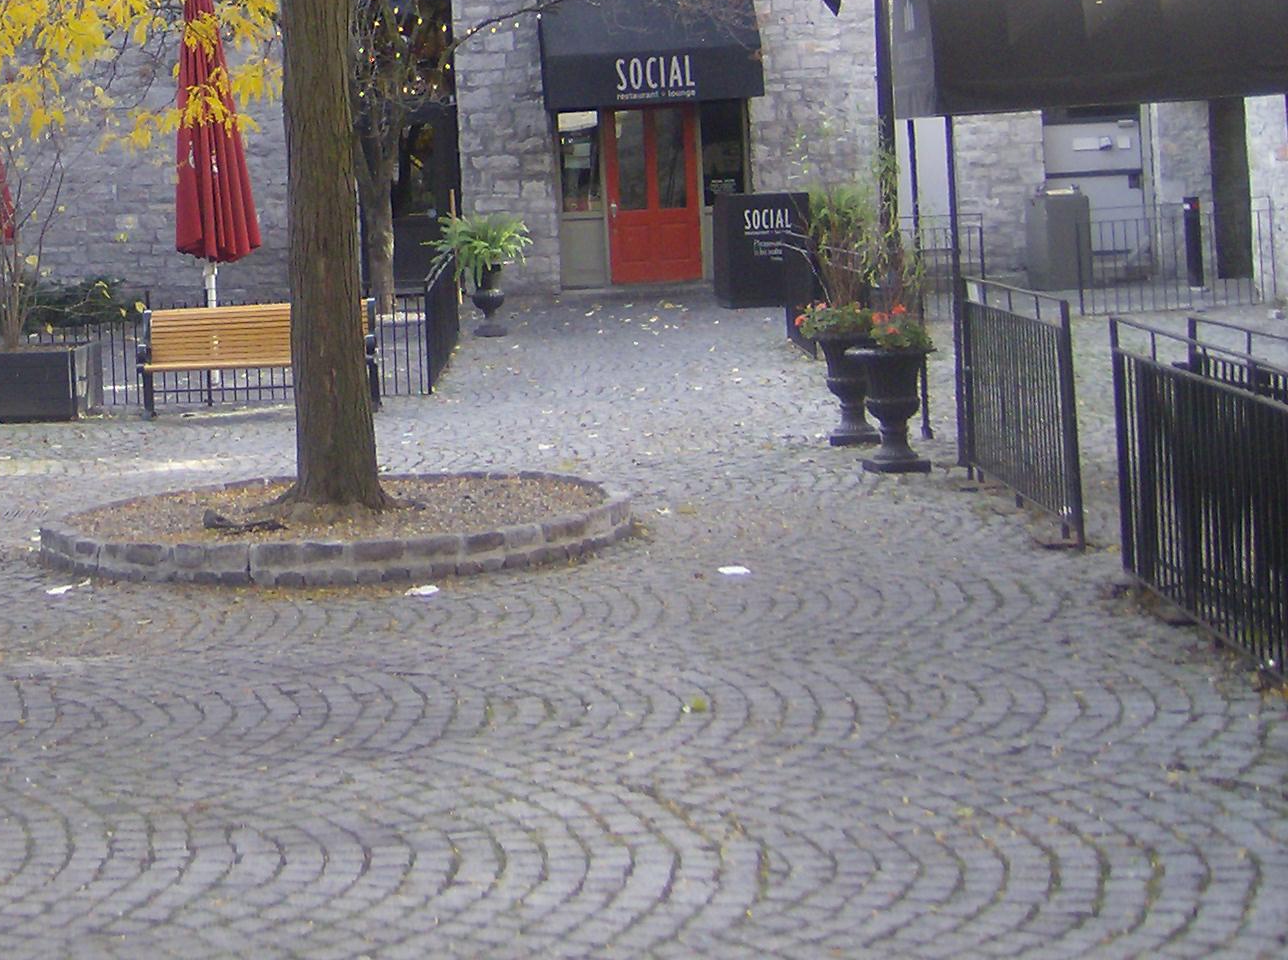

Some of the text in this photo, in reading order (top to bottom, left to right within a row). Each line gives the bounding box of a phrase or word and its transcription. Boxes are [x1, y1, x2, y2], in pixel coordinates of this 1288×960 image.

[616, 55, 696, 91] SOCIAL
[616, 89, 696, 100] restaurant lounge
[744, 208, 791, 230] SOCIAL
